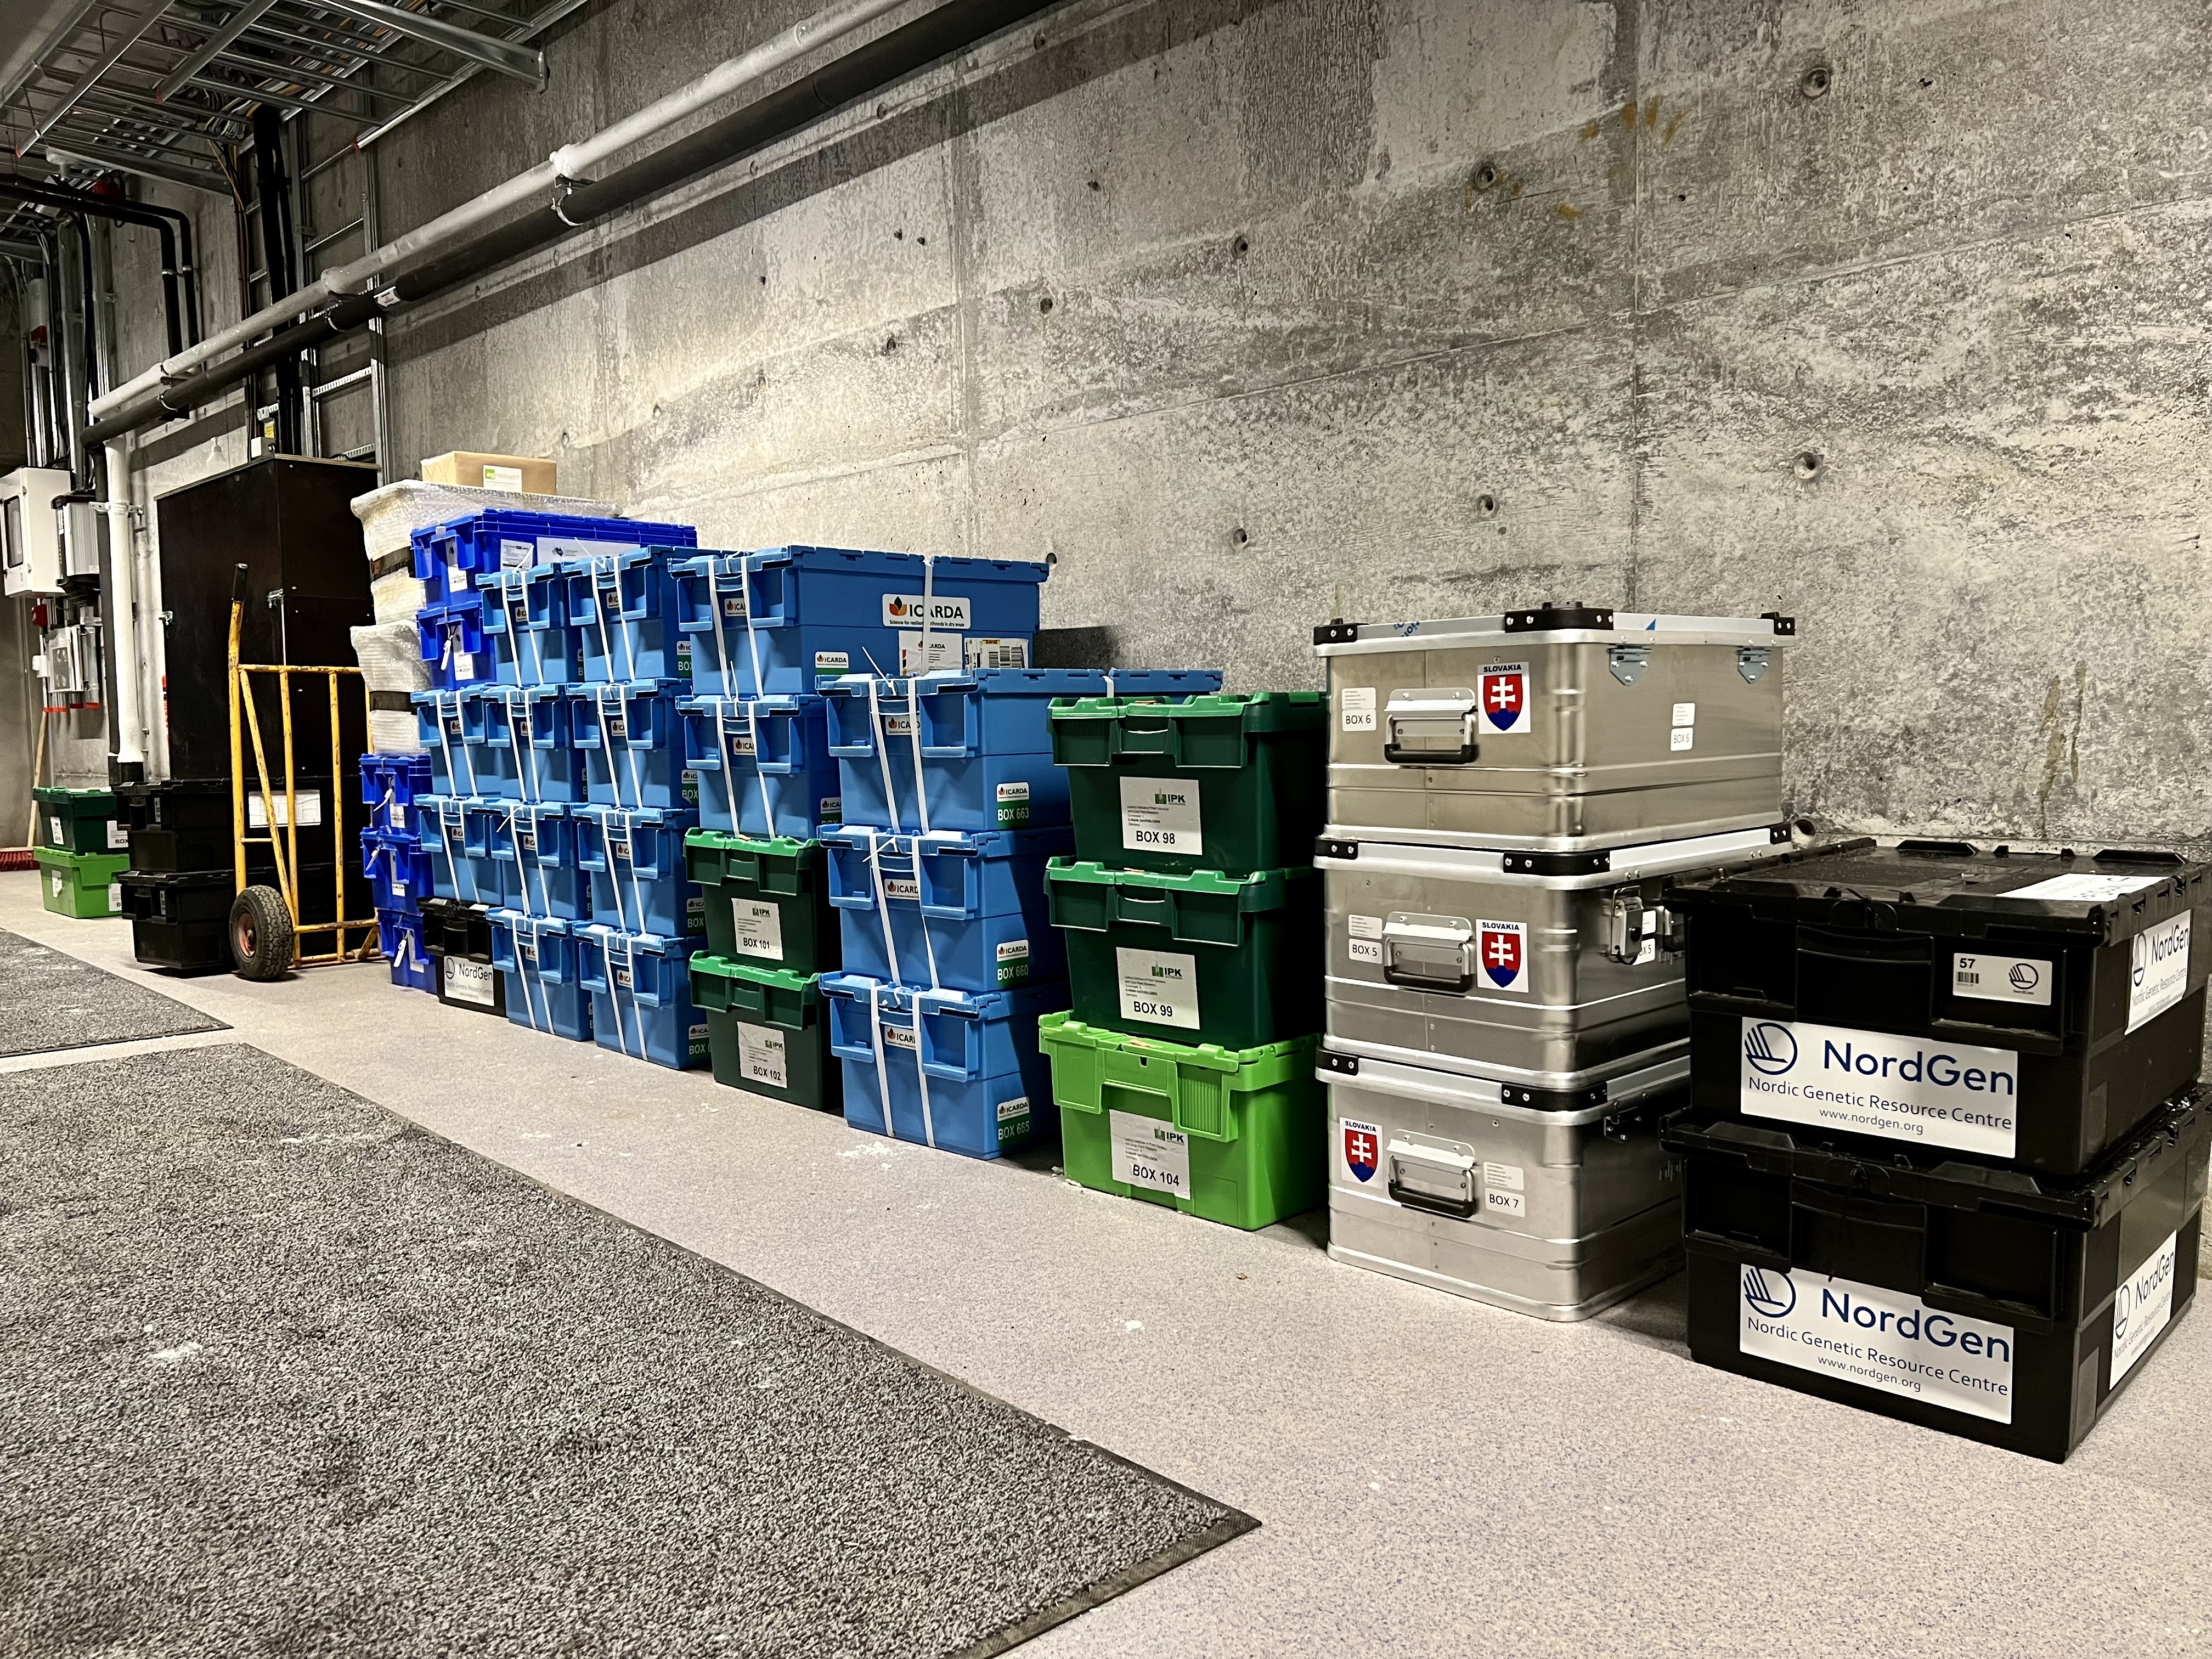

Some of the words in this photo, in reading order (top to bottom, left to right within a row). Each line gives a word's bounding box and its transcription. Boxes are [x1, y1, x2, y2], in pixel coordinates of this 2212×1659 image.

[910, 604, 964, 619] ICRDA
[1483, 664, 1522, 673] SLOVAKIA
[1346, 715, 1363, 724] BOX
[1365, 714, 1371, 724] 6
[1673, 734, 1685, 743] BOX
[1686, 733, 1690, 743] 6
[1168, 794, 1186, 803] IPK
[997, 809, 1014, 821] BOX
[1016, 807, 1029, 819] 663
[1136, 830, 1160, 843] BOX
[1163, 832, 1175, 844] 98
[897, 884, 918, 894] ICARD
[688, 918, 704, 928] BOX
[1482, 922, 1520, 931] SLOVAKIA
[743, 937, 758, 948] BOX
[759, 940, 770, 950] 101
[1006, 945, 1027, 954] ICARDA
[1352, 944, 1370, 955] BOX
[1372, 947, 1377, 956] 5
[2151, 924, 2188, 965] NordGen
[1959, 957, 1976, 969] 57
[459, 963, 493, 981] NordGen
[997, 967, 1014, 981] BOX
[1016, 964, 1029, 977] 660
[1164, 967, 1182, 977] IPK
[1134, 1001, 1158, 1015] BOX
[1160, 1005, 1172, 1017] 99
[689, 1043, 706, 1054] BOX
[772, 1042, 783, 1050] IPK
[753, 1065, 768, 1077] BOX
[770, 1070, 781, 1081] 102
[1824, 1040, 2013, 1096] NordGen
[1006, 1102, 1028, 1113] ICARDA
[1749, 1076, 1799, 1097] Nordic
[1803, 1085, 1865, 1107] Genetic
[1869, 1095, 1947, 1119] Resource
[1952, 1107, 2012, 1130] Centre
[1345, 1120, 1376, 1132] SLOVAKIA
[1819, 1108, 1924, 1136] www.nordgen.org
[998, 1125, 1015, 1140] BOX
[1017, 1120, 1030, 1135] 665
[1166, 1132, 1184, 1143] IPK
[1133, 1164, 1156, 1182] BOX
[1160, 1171, 1180, 1187] 104
[1489, 1193, 1510, 1207] BOX
[1513, 1199, 1519, 1209] 7
[2135, 1251, 2174, 1309] NordGen
[1822, 1288, 2010, 1363] NordGen
[1748, 1316, 1798, 1341] Nordic
[1802, 1331, 1863, 1359] Genetic
[1867, 1347, 1944, 1379] Resource
[1949, 1369, 2008, 1396] Centre
[1818, 1355, 1921, 1392] www.nordgen.org
